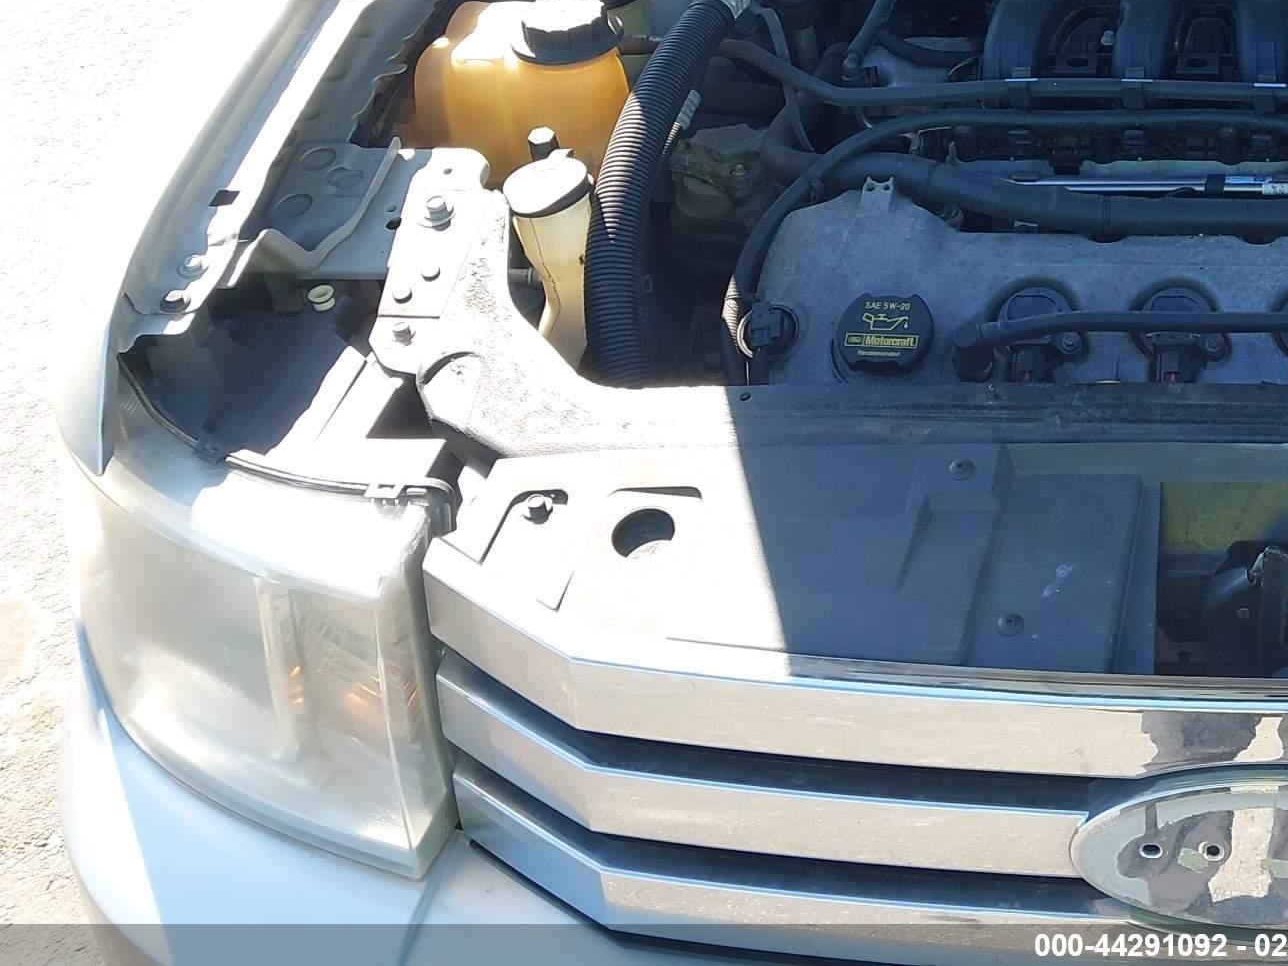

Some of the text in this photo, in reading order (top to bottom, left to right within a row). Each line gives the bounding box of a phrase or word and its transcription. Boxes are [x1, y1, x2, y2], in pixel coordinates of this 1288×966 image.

[865, 301, 911, 310] SAE 5W-20
[865, 335, 915, 347] Motorcraft
[857, 349, 901, 357] Recommended
